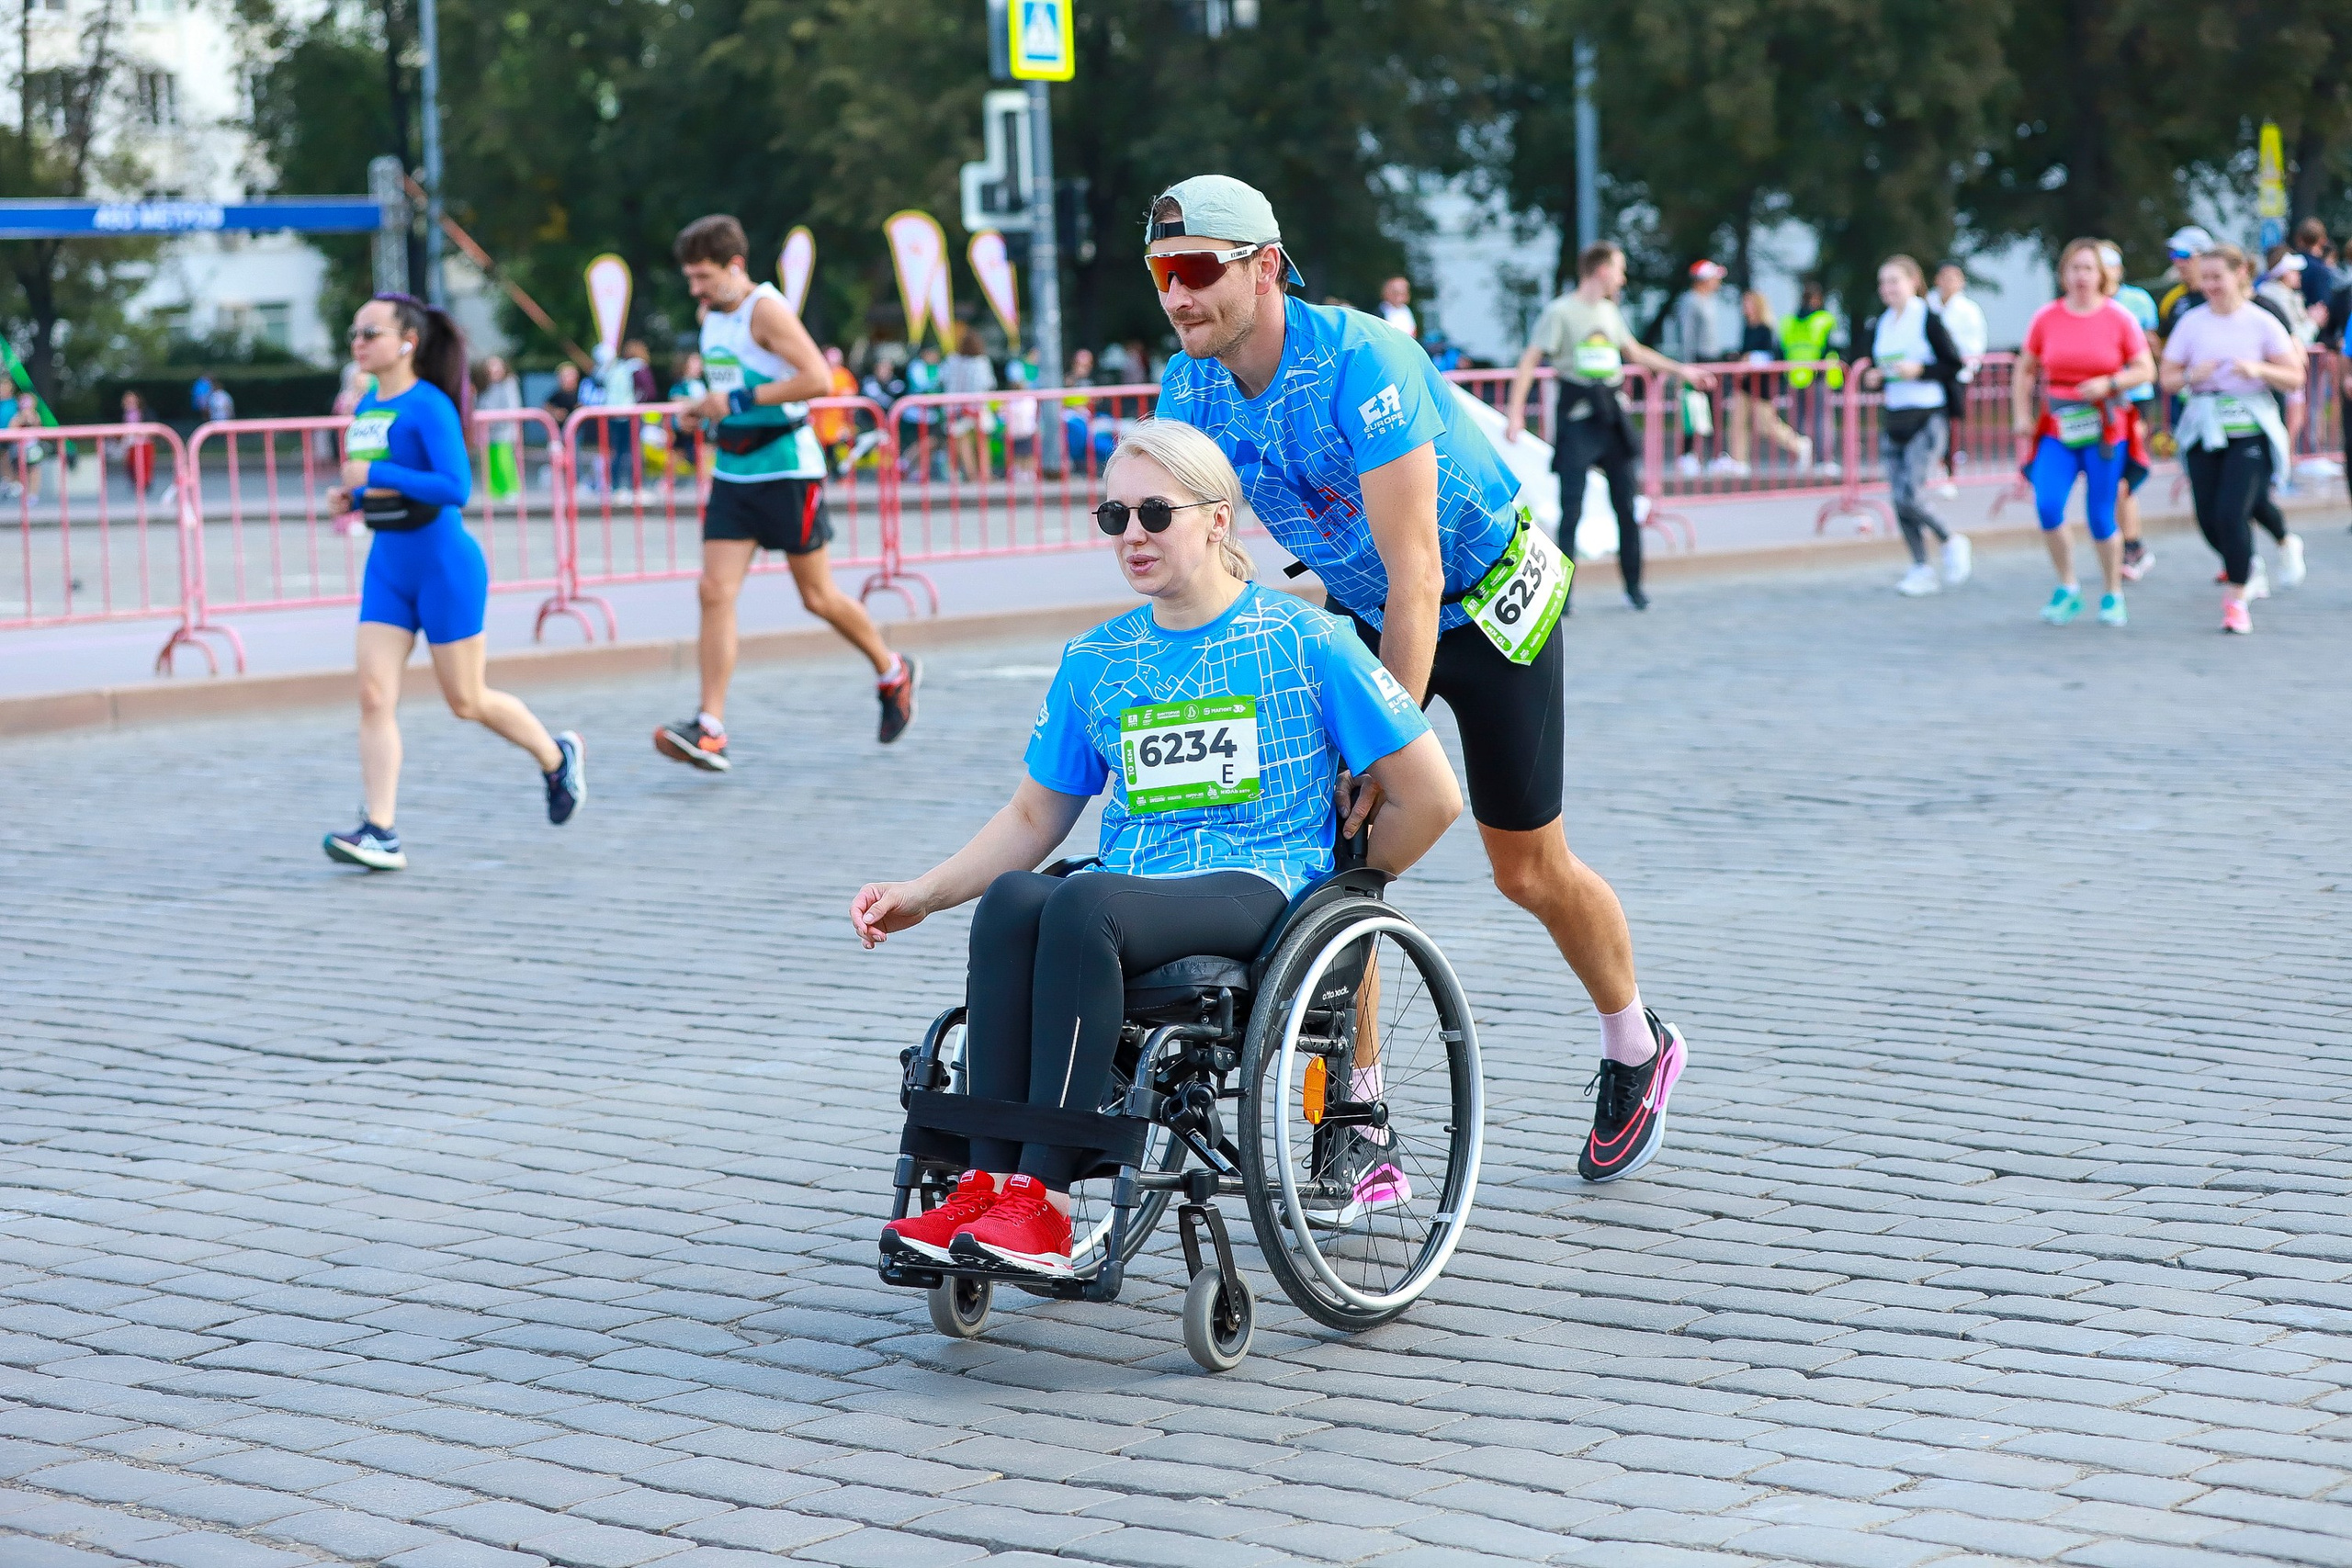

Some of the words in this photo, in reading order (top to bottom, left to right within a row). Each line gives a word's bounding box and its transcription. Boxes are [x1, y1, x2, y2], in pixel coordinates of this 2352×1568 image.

[1363, 412, 1404, 433] EUROPE
[1495, 542, 1547, 625] 6235
[1139, 727, 1238, 767] 6234
[1127, 766, 1136, 776] 10
[1223, 764, 1234, 784] E
